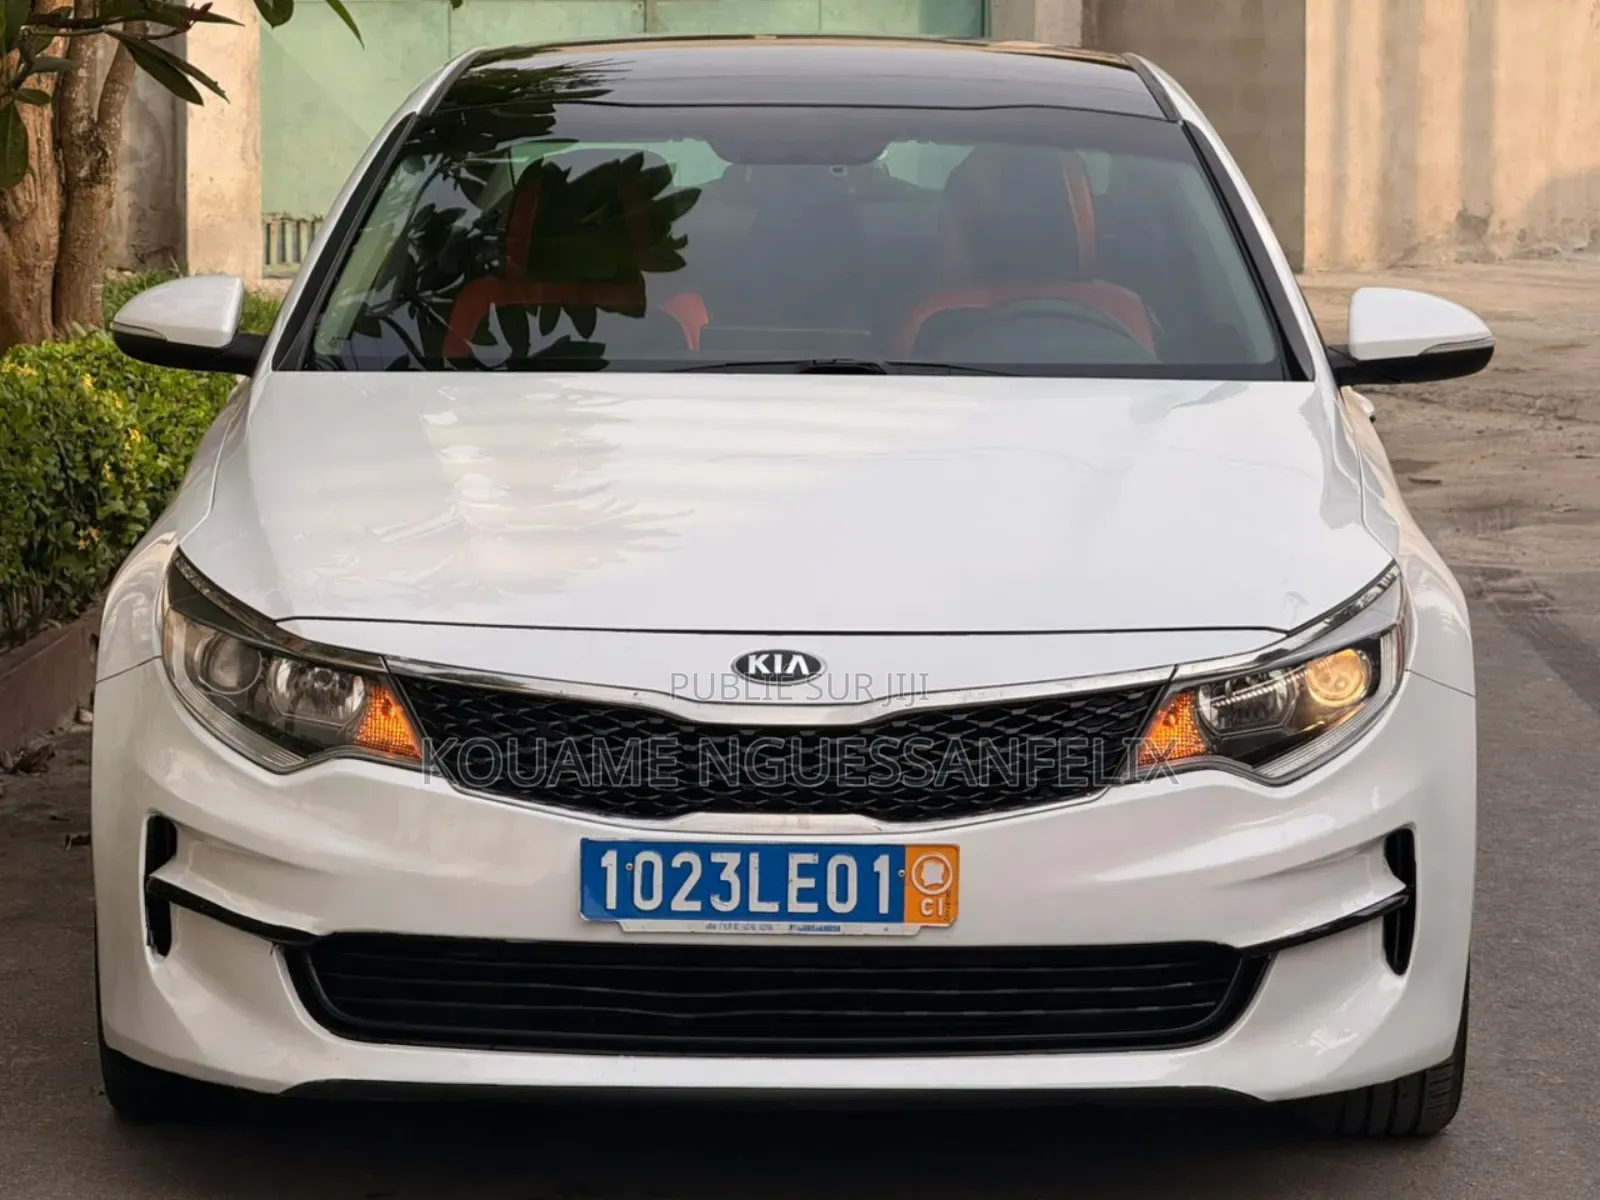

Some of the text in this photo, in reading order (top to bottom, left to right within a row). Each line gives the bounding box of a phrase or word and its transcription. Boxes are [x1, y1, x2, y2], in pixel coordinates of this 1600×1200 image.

[748, 654, 810, 675] KIA
[600, 850, 890, 916] 1023LE01
[920, 896, 944, 917] CI
